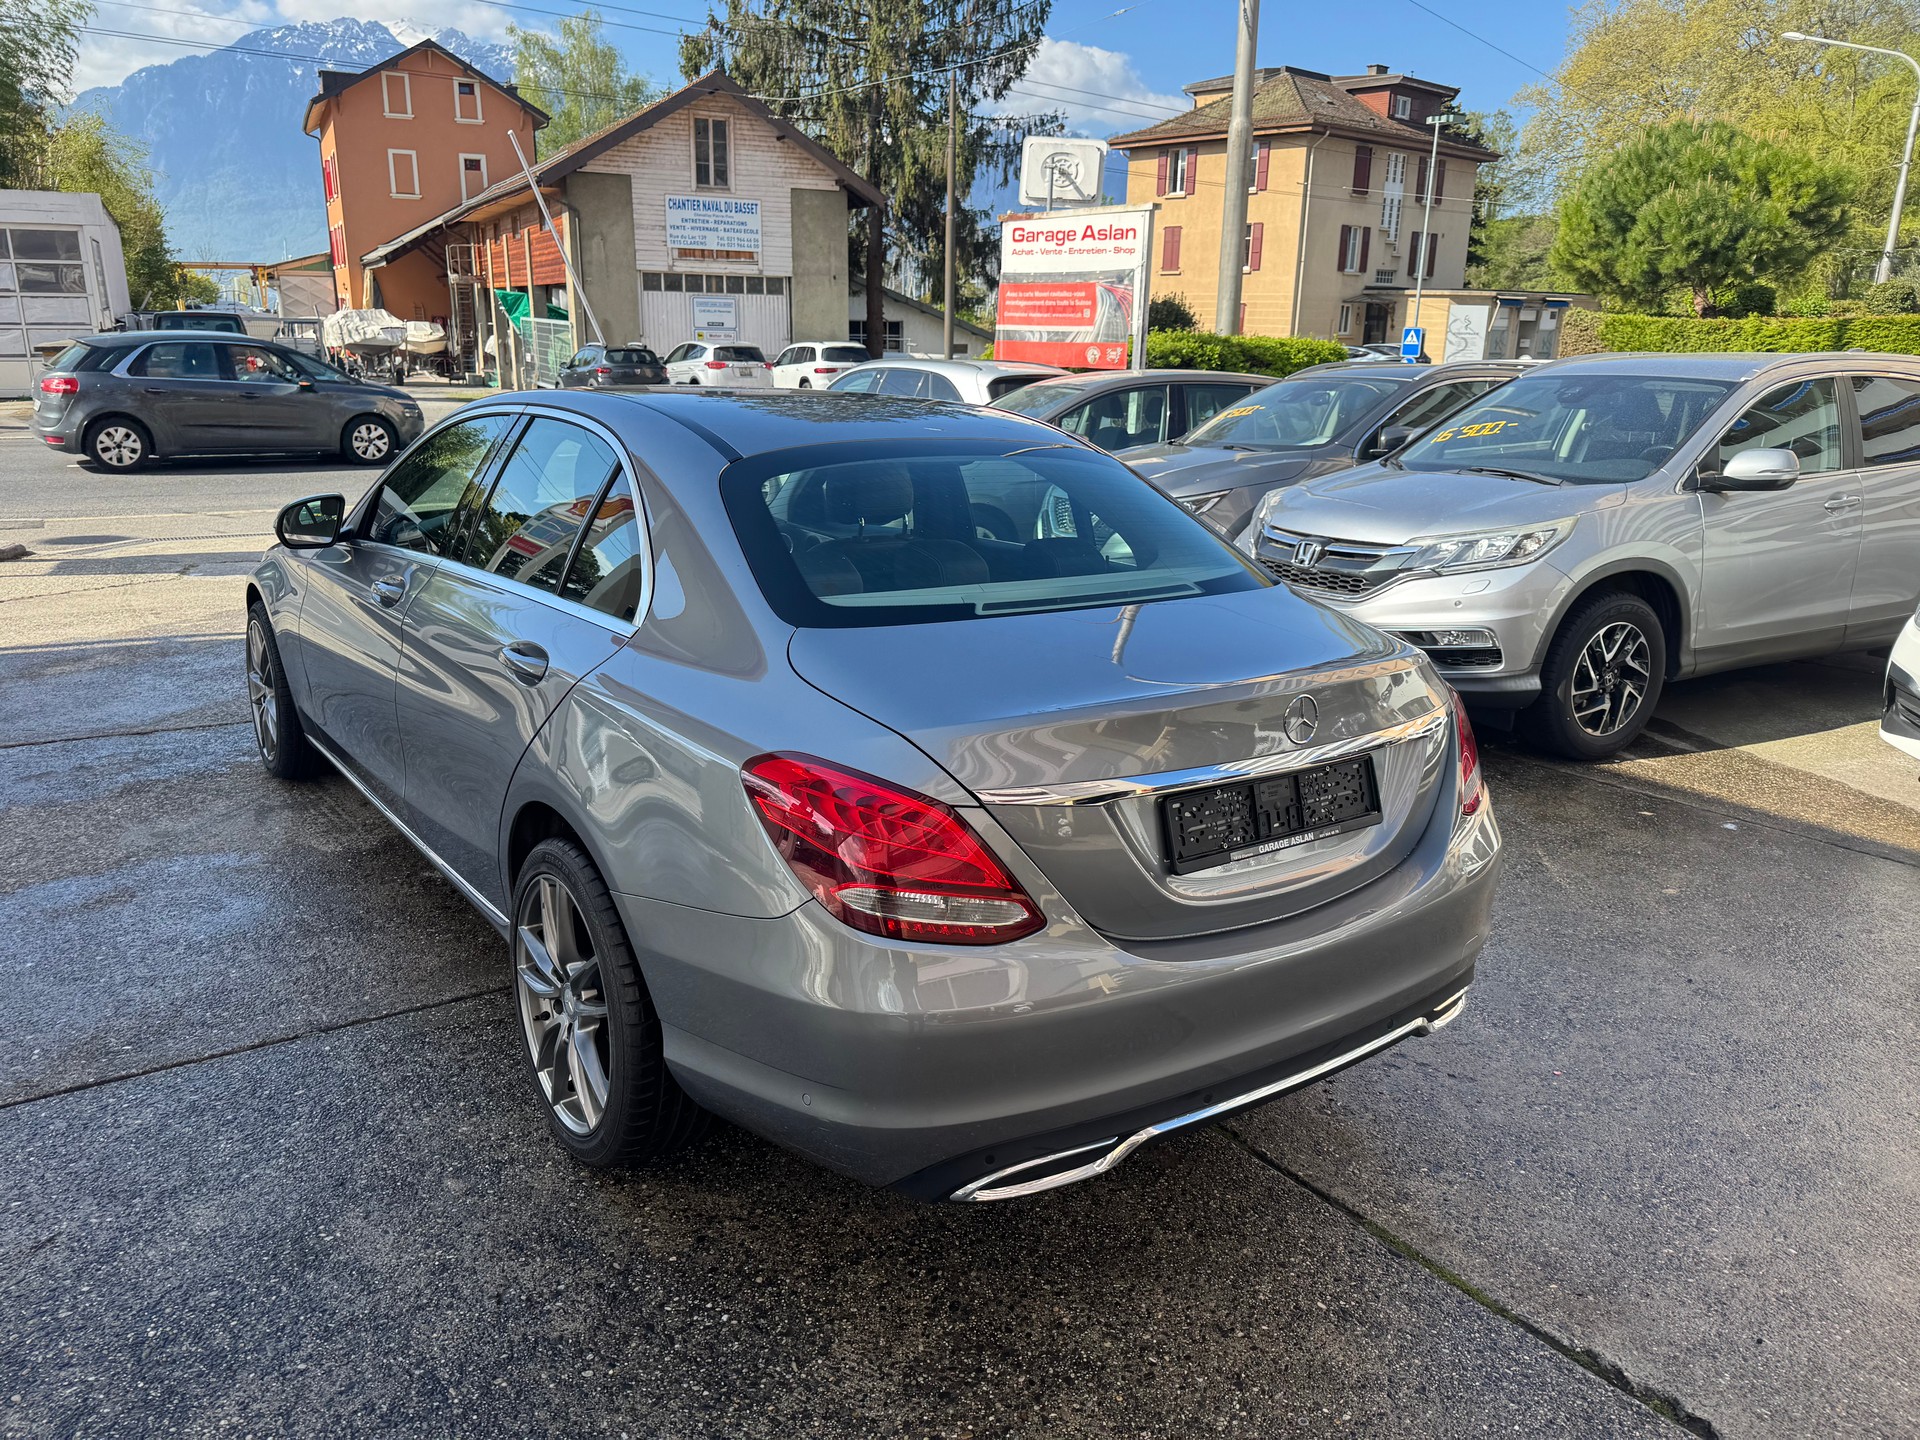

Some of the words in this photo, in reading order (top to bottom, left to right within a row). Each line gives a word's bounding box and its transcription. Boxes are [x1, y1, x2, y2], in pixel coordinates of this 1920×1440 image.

[668, 198, 701, 211] CHANTIER
[702, 199, 723, 212] NAVAL
[724, 201, 733, 213] DU
[734, 201, 758, 215] BASSET
[1012, 227, 1077, 246] Garage
[1081, 223, 1137, 241] Aslan
[1011, 248, 1035, 256] Achat
[1039, 247, 1063, 255] Vente
[1068, 246, 1107, 255] Entretien
[1113, 246, 1136, 256] Shop
[1258, 838, 1290, 854] GARAGE
[1290, 831, 1315, 846] ASLAN
